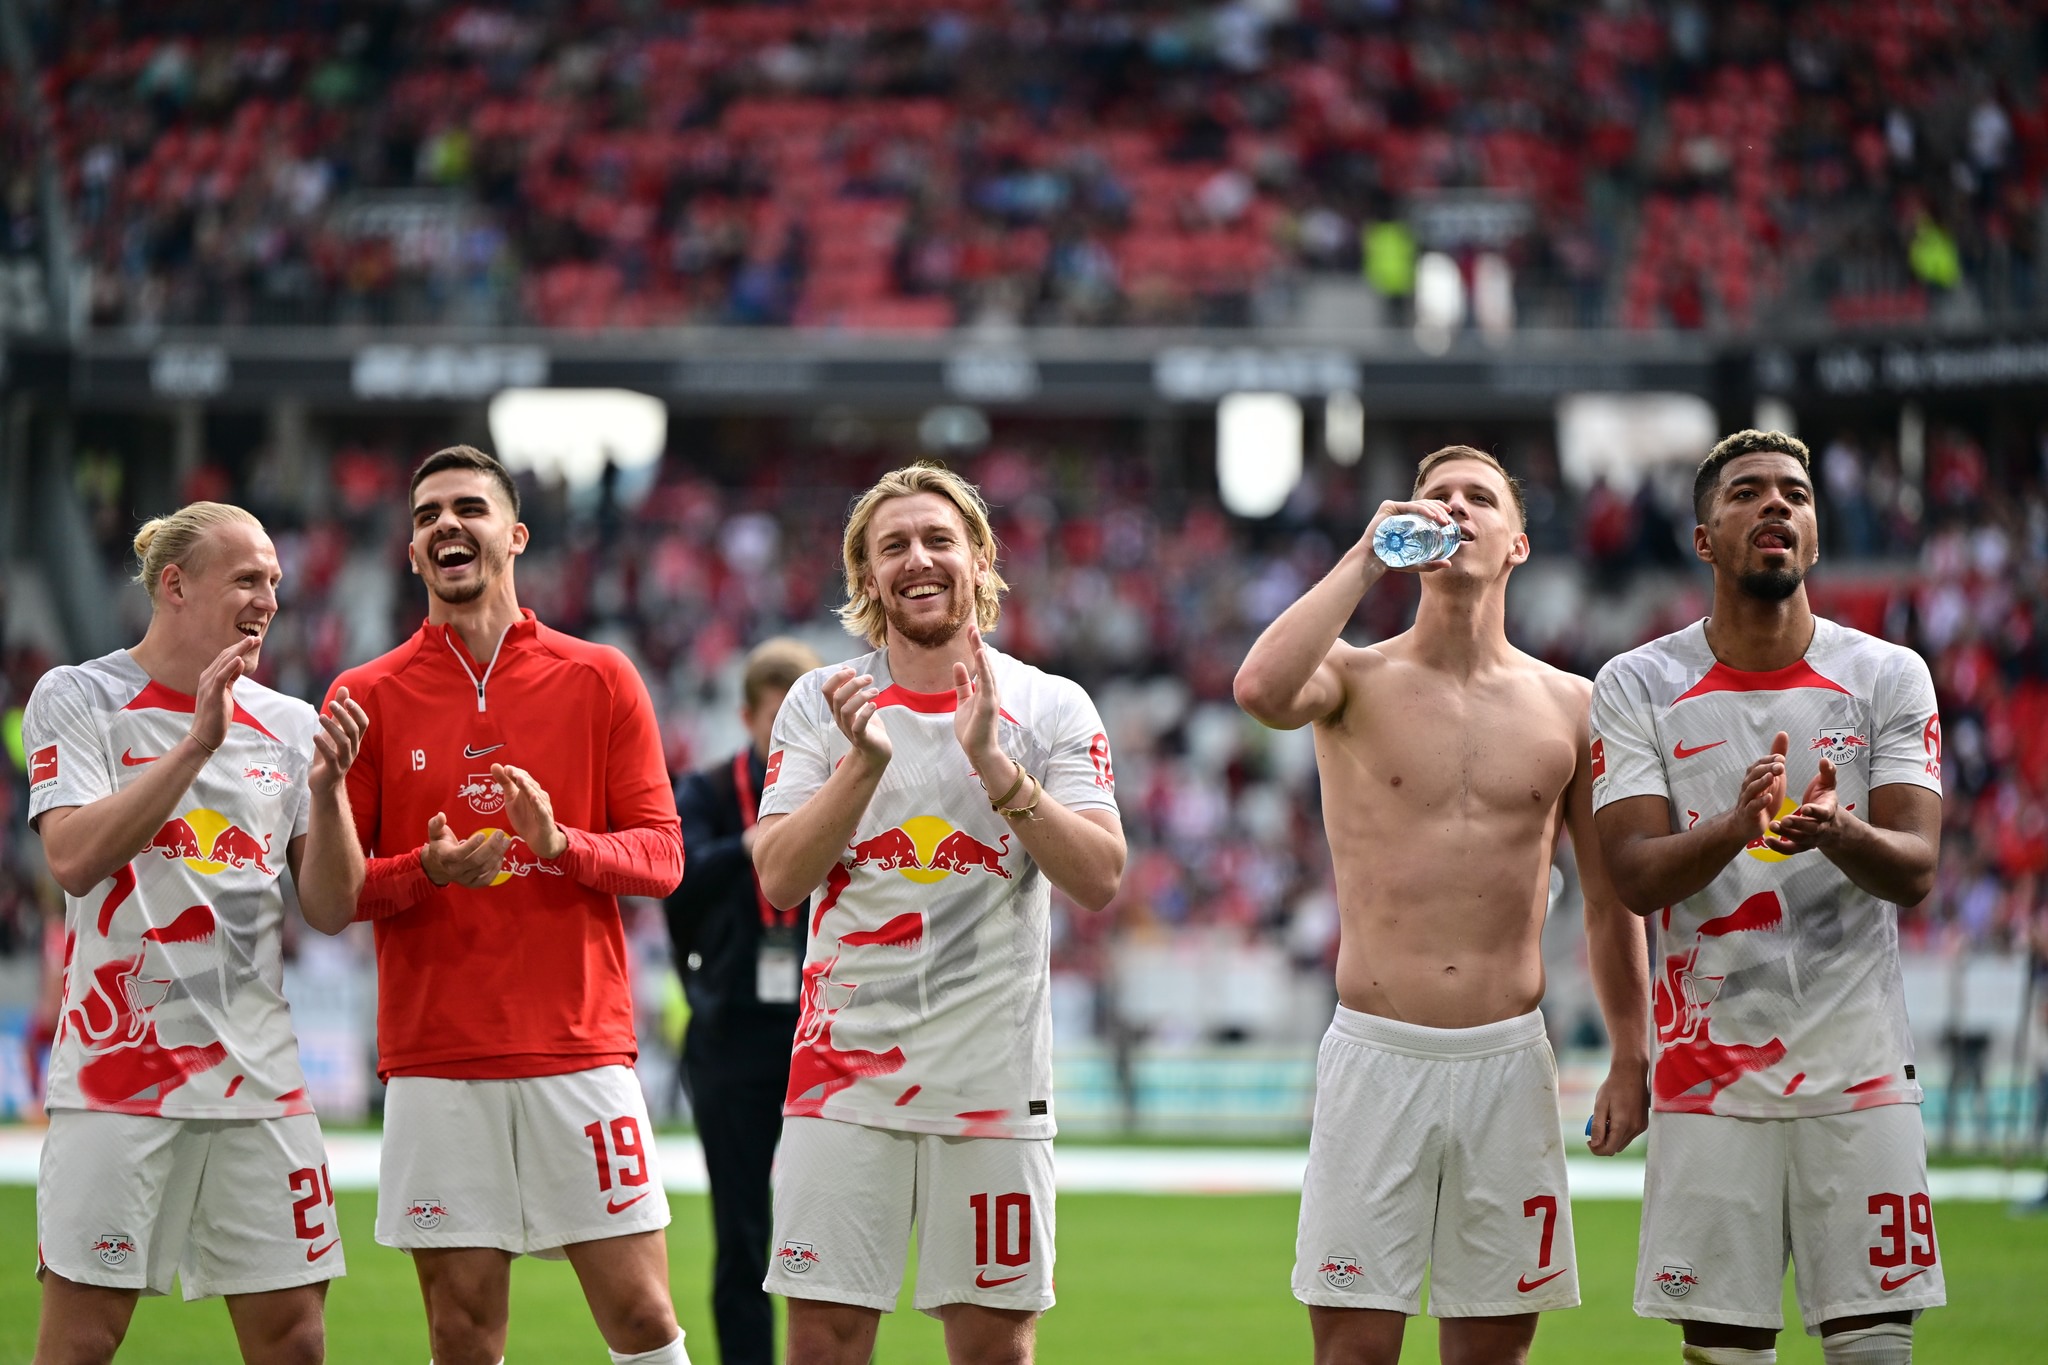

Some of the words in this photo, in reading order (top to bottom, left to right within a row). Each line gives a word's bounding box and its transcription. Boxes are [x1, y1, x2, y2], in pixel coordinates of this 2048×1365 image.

[411, 749, 426, 771] 19
[1832, 748, 1855, 762] LEIPZIG
[1925, 761, 1940, 780] AO
[480, 796, 503, 811] LEIPZIG
[584, 1115, 649, 1192] 19
[970, 1192, 1031, 1267] 10
[1523, 1195, 1557, 1269] 7
[1867, 1192, 1937, 1268] 39
